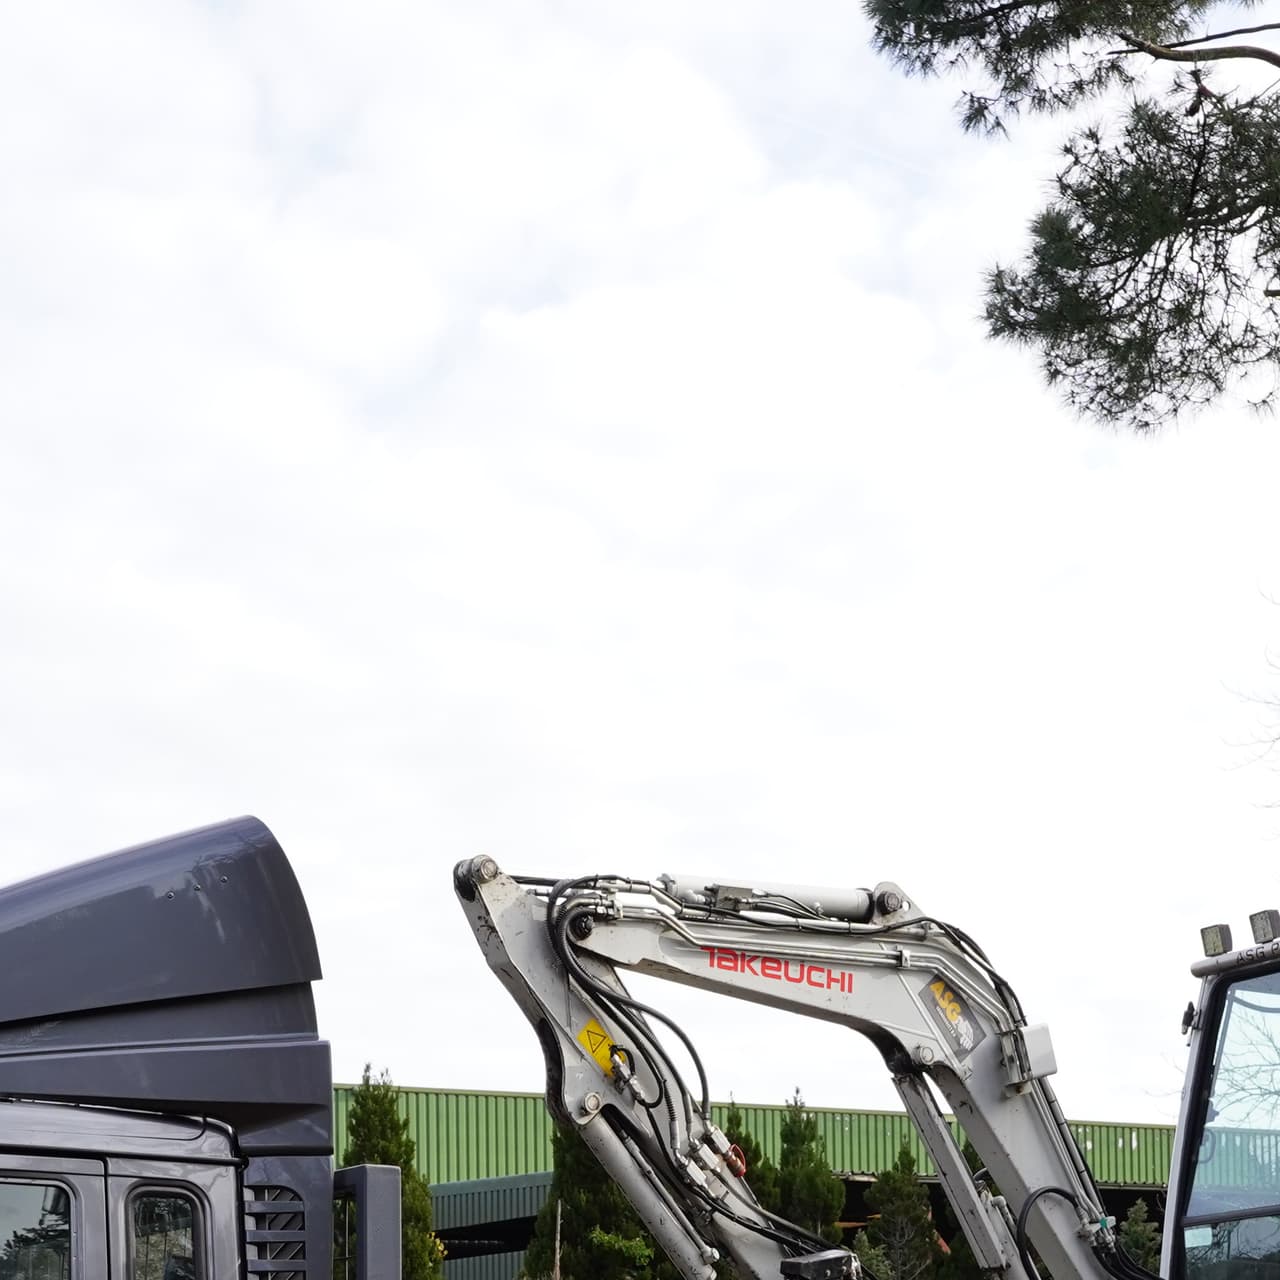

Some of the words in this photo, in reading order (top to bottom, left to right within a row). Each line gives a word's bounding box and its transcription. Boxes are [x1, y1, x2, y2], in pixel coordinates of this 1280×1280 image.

[699, 945, 854, 994] TAKEUCHI
[1236, 946, 1265, 965] ASG
[929, 981, 961, 1022] ASG
